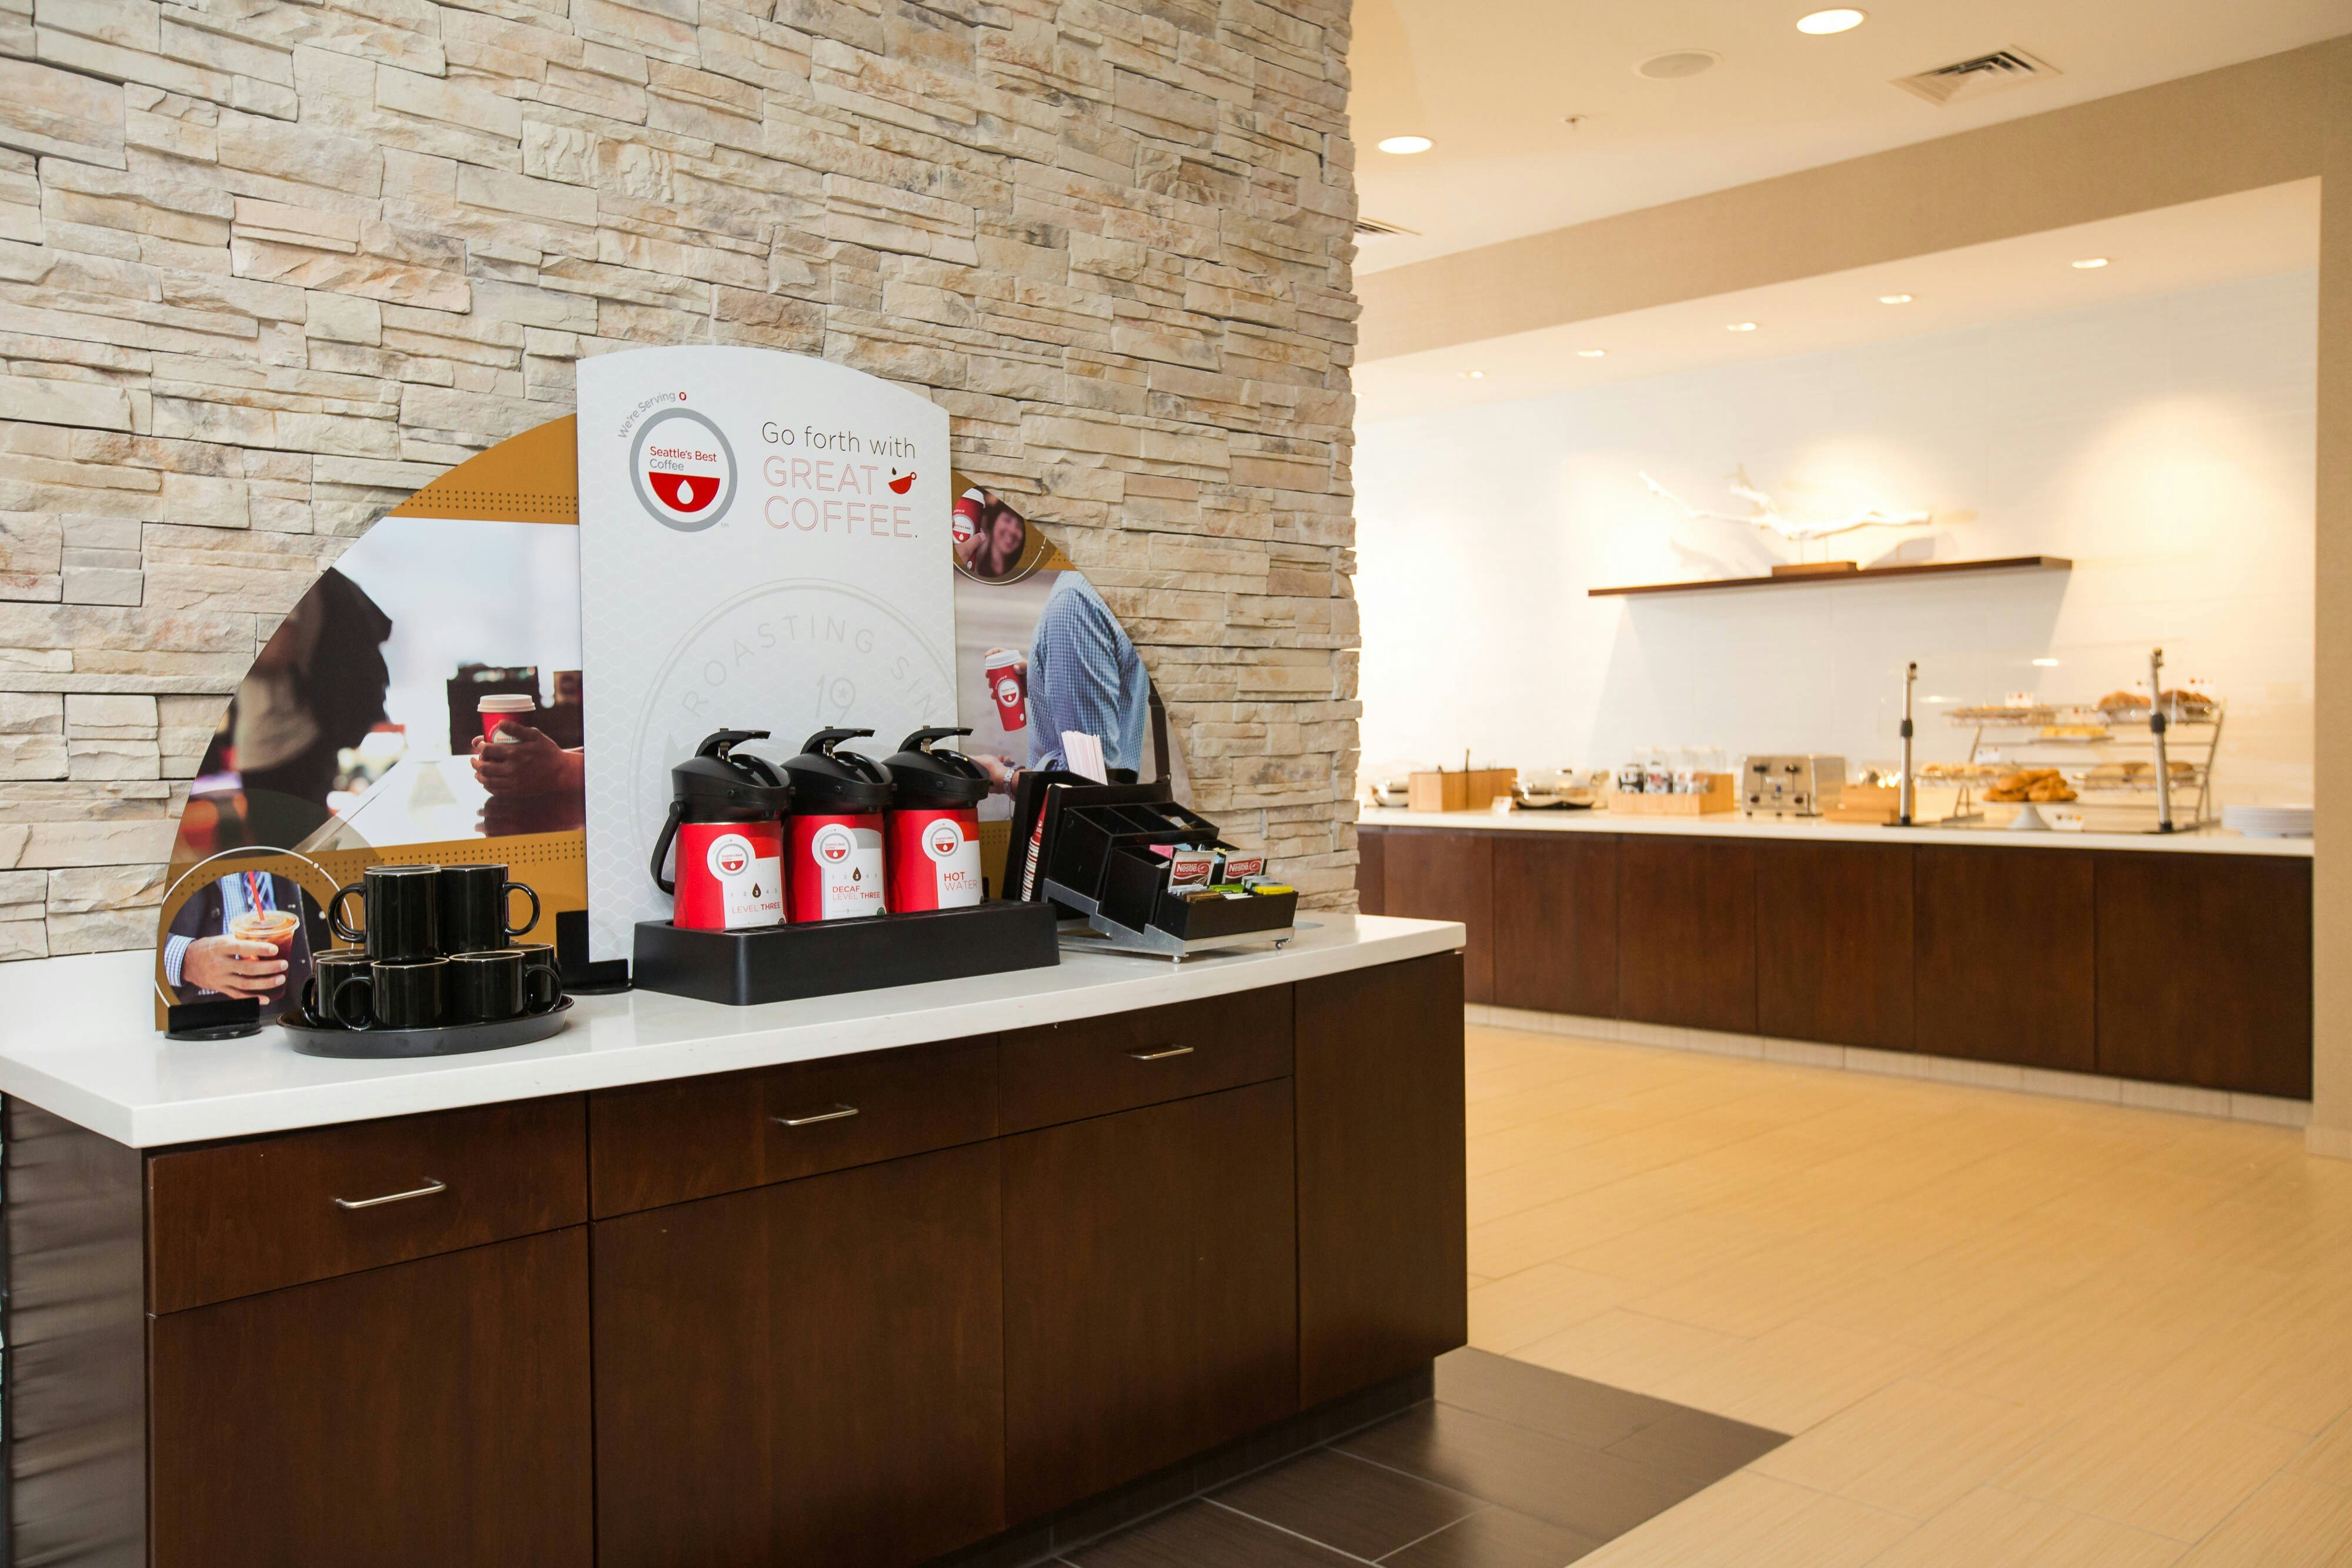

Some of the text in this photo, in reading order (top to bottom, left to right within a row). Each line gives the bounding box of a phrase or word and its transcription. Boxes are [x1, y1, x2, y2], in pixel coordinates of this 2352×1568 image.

[617, 392, 676, 439] We're Serving
[761, 421, 916, 459] Go forth with
[649, 446, 717, 463] Seattle's Best
[649, 459, 684, 472] Coffee
[763, 455, 879, 495] GREAT
[681, 614, 938, 721] ROASTING SIN
[944, 871, 965, 882] HOT
[944, 880, 978, 892] WATER
[832, 892, 858, 901] LEVEL
[732, 901, 781, 914] LEVEL THREE
